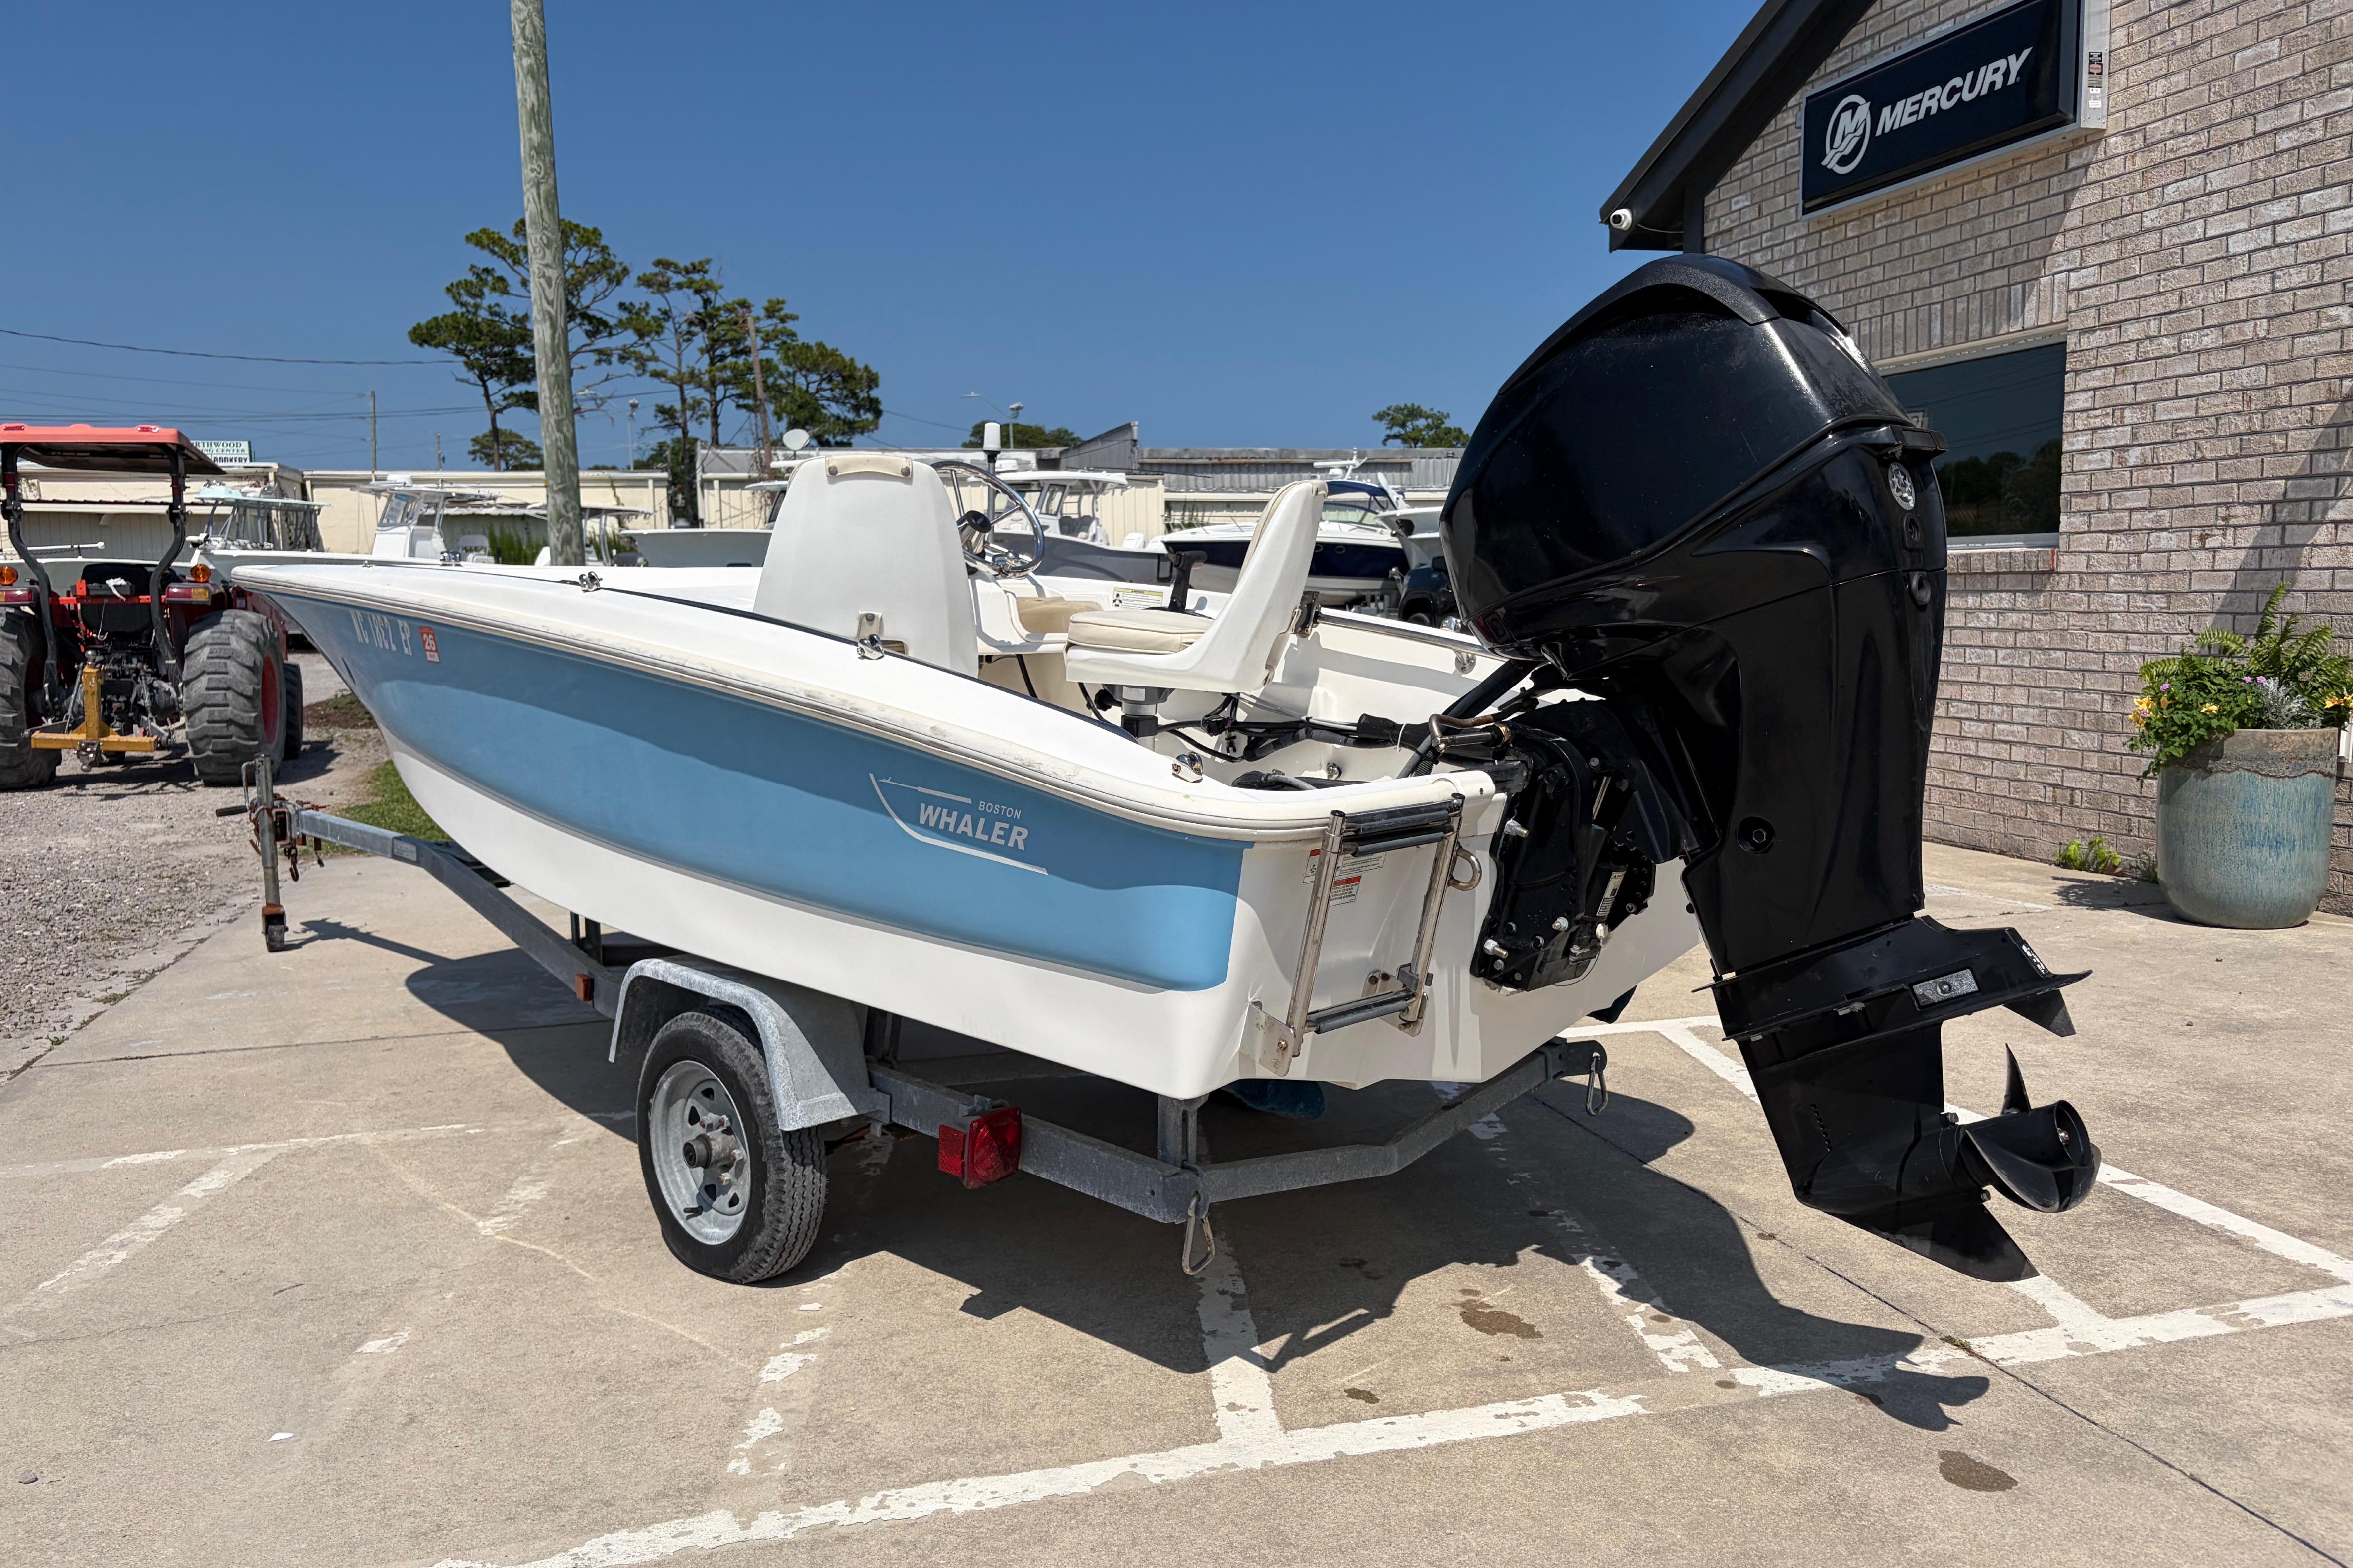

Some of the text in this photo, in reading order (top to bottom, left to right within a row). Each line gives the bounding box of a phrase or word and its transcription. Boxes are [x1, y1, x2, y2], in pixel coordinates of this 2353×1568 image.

[1875, 46, 2033, 136] MERCURY
[423, 634, 436, 651] 26
[919, 803, 1029, 851] WHALER
[978, 801, 1022, 820] BOSTON
